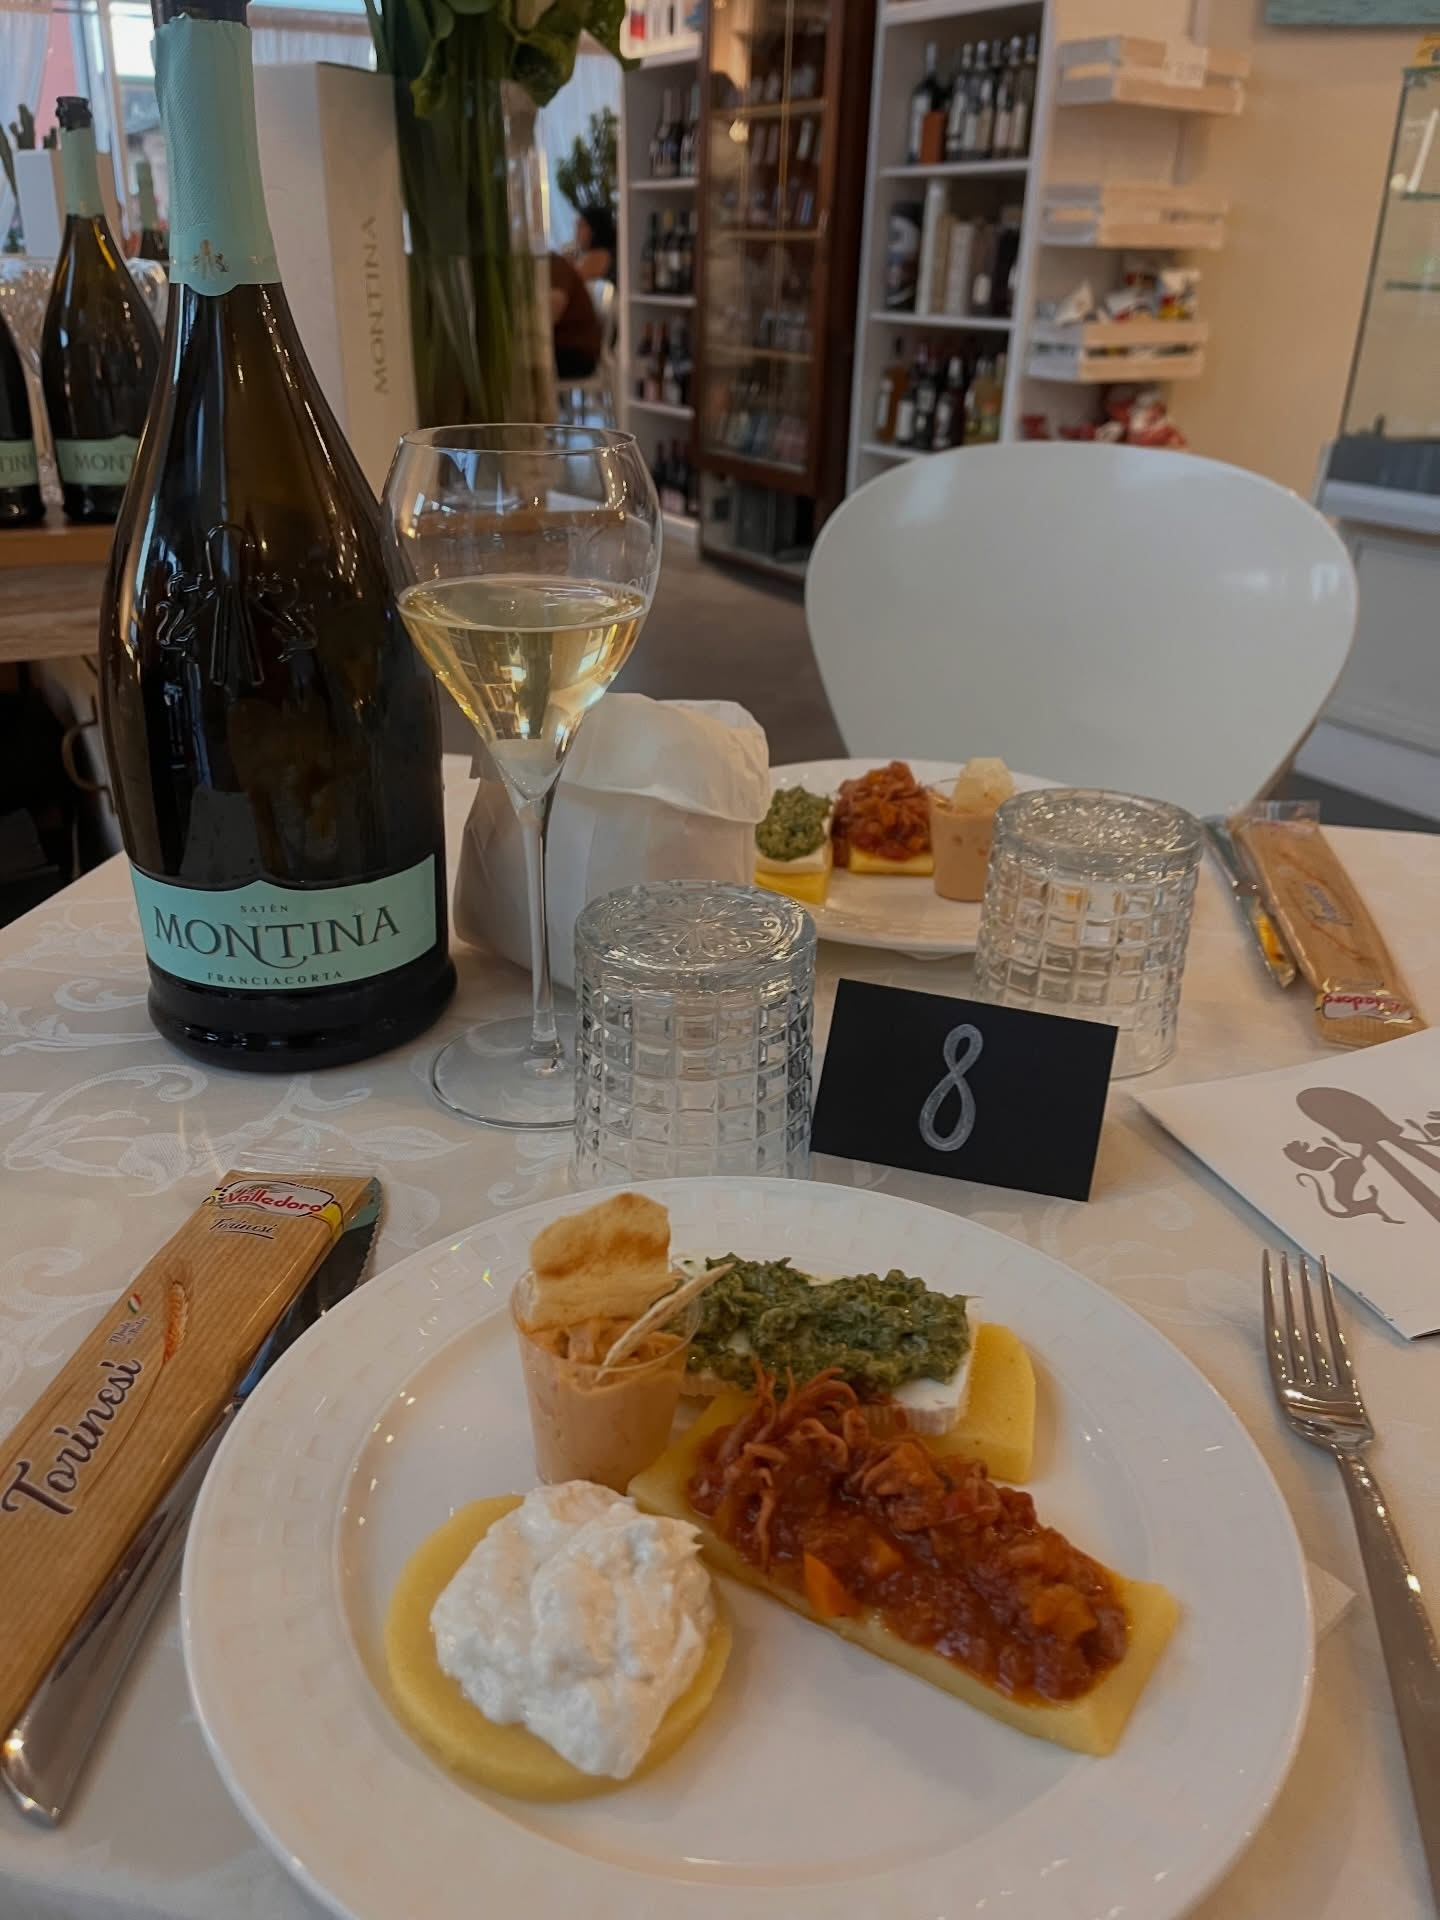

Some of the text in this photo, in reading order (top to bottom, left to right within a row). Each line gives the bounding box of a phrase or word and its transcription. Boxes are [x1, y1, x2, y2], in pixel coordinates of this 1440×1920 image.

[360, 216, 391, 396] MONTINA
[153, 905, 400, 969] MONTINA
[207, 970, 344, 986] FRANCIACORTA
[919, 1023, 984, 1152] 8
[209, 1217, 278, 1234] Torinesi
[227, 1189, 323, 1213] Valledoro
[1, 1359, 143, 1515] Torinesi
